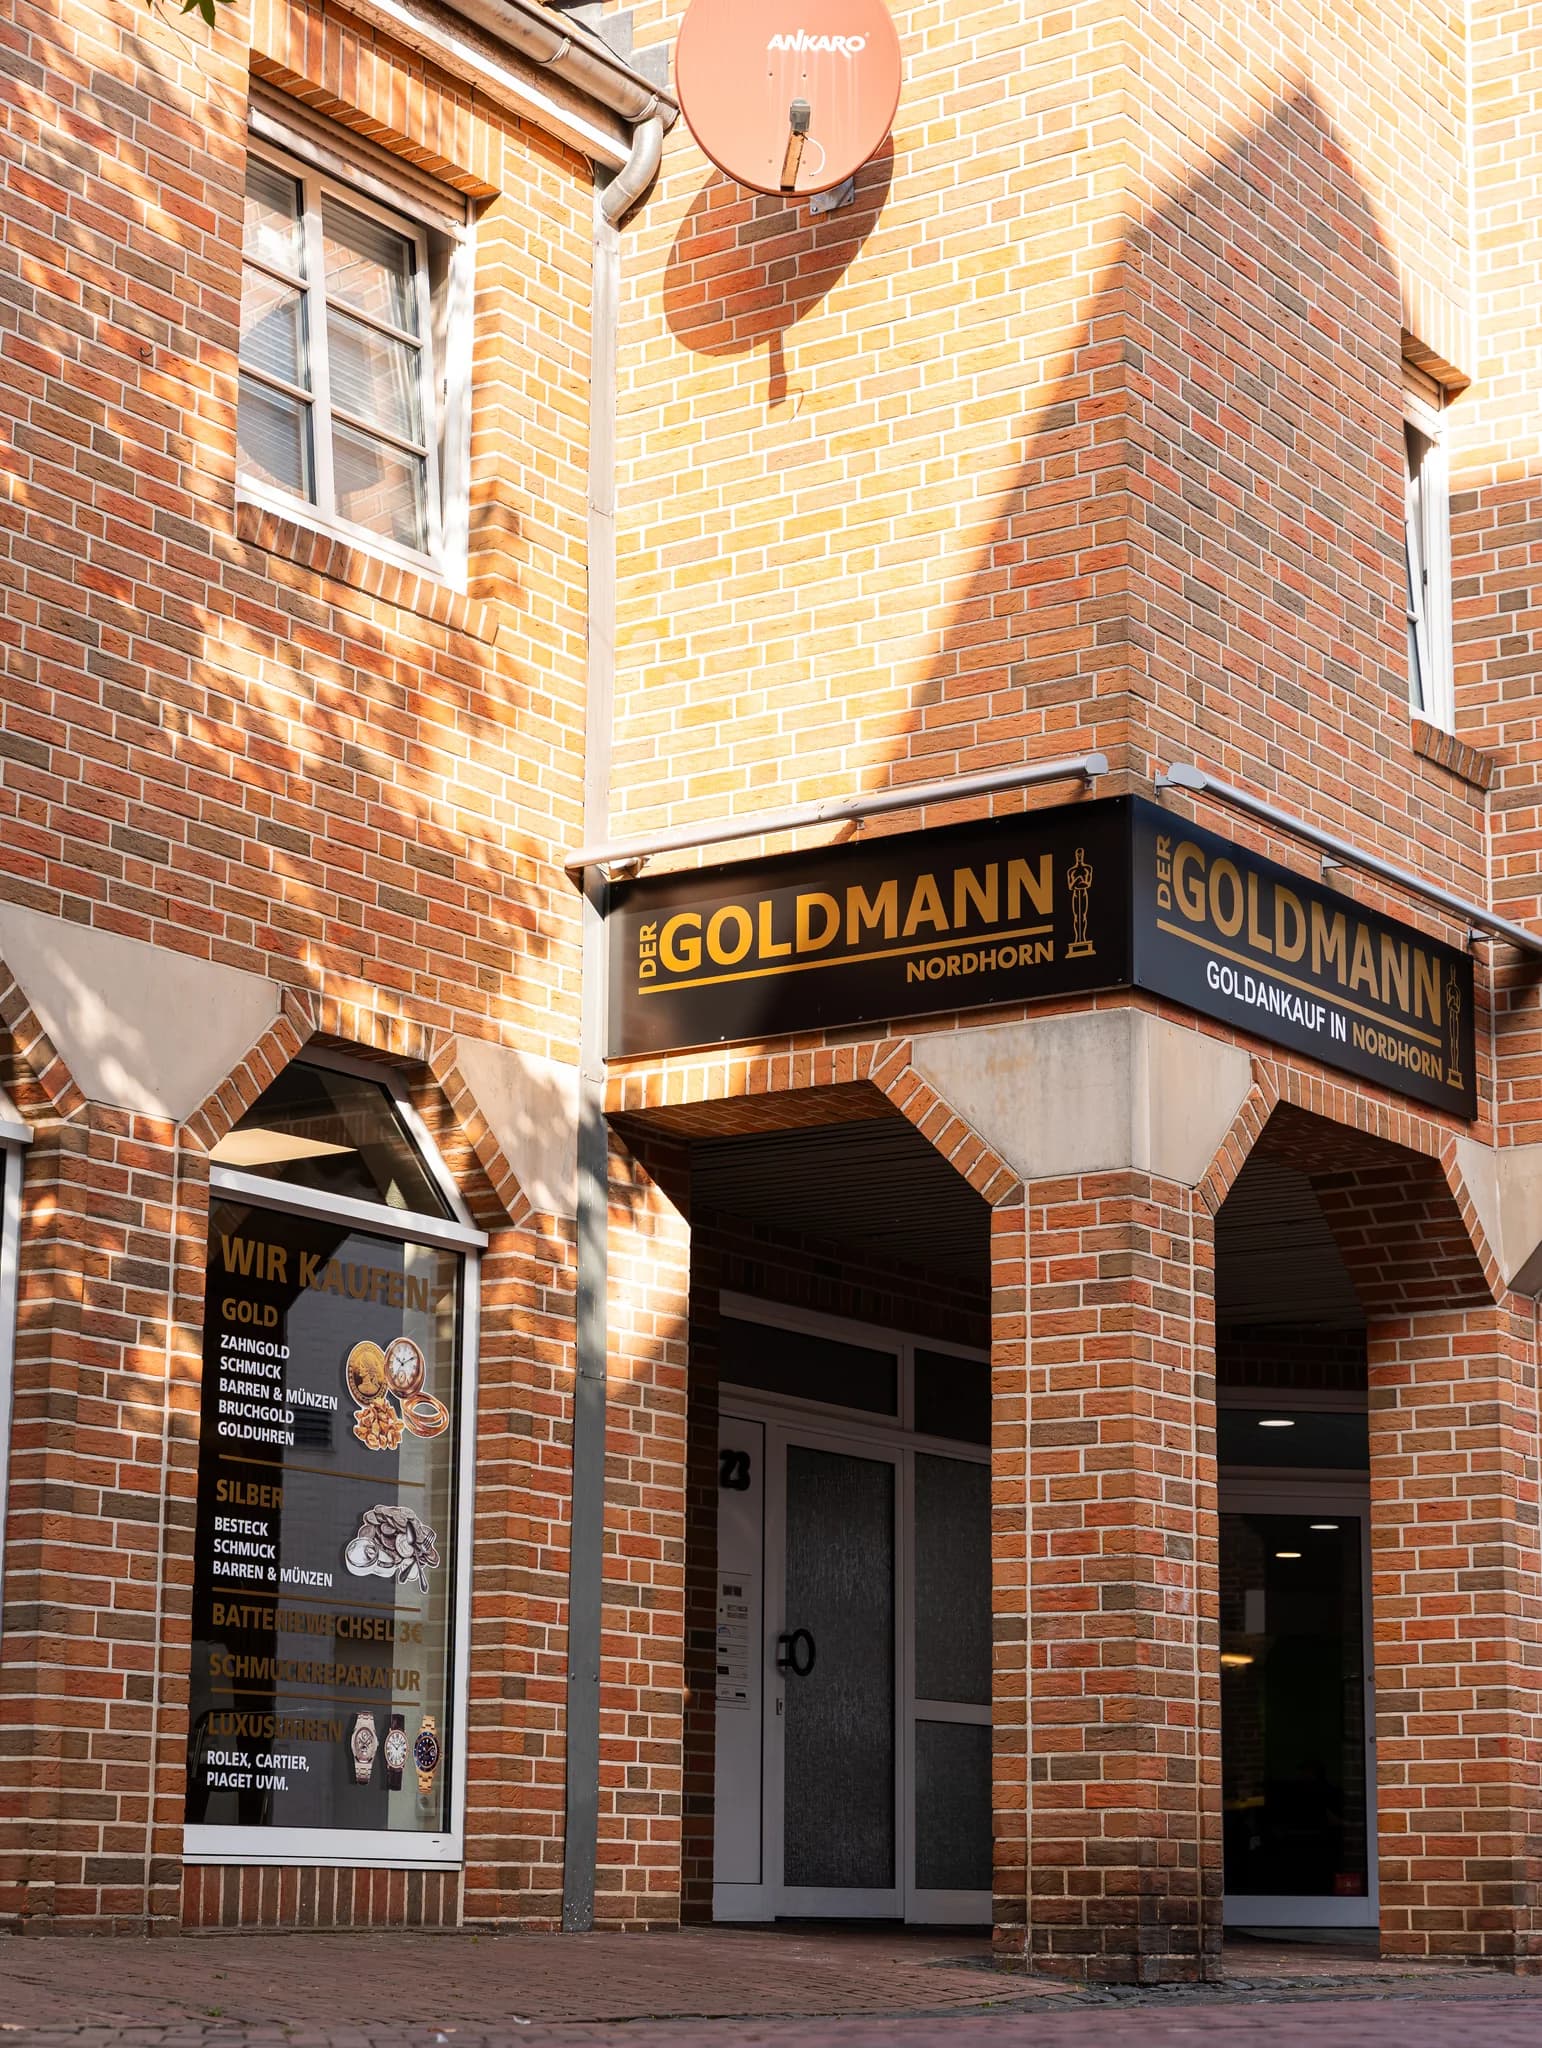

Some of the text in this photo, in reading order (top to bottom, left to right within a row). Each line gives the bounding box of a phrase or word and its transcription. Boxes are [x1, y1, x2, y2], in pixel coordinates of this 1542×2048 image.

[767, 28, 866, 59] ANKARO
[1156, 835, 1172, 911] DER
[658, 853, 1054, 973] GOLDMANN
[1172, 840, 1442, 1027] GOLDMANN
[638, 920, 658, 979] DER
[906, 940, 1054, 983] NORDHORN
[1206, 960, 1443, 1083] GOLDANKAUF IN NORDHORN
[221, 1234, 288, 1284] WIR
[221, 1298, 278, 1328] GOLD
[220, 1334, 290, 1360] ZAHNGOLD
[220, 1356, 282, 1380] SCHMUCK
[219, 1378, 338, 1410] BARREN & MÜNZEN
[218, 1399, 294, 1424] BRUCHGOLD
[217, 1421, 294, 1446] GOLDUHREN
[719, 1449, 750, 1491] 23
[215, 1479, 284, 1509] SILBER
[214, 1516, 269, 1537] BESTECK
[213, 1538, 276, 1559] SCHMUCK
[212, 1560, 333, 1588] BARREN & MÜNZEN
[212, 1602, 423, 1644] BATTERIEWECHSEL 3€
[209, 1652, 421, 1691] SCHMUCKREPARATUR
[207, 1711, 344, 1743] LUXUSUHREN
[207, 1750, 310, 1772] ROLEX, CARTIER,
[206, 1771, 289, 1791] PIAGET UVM.
